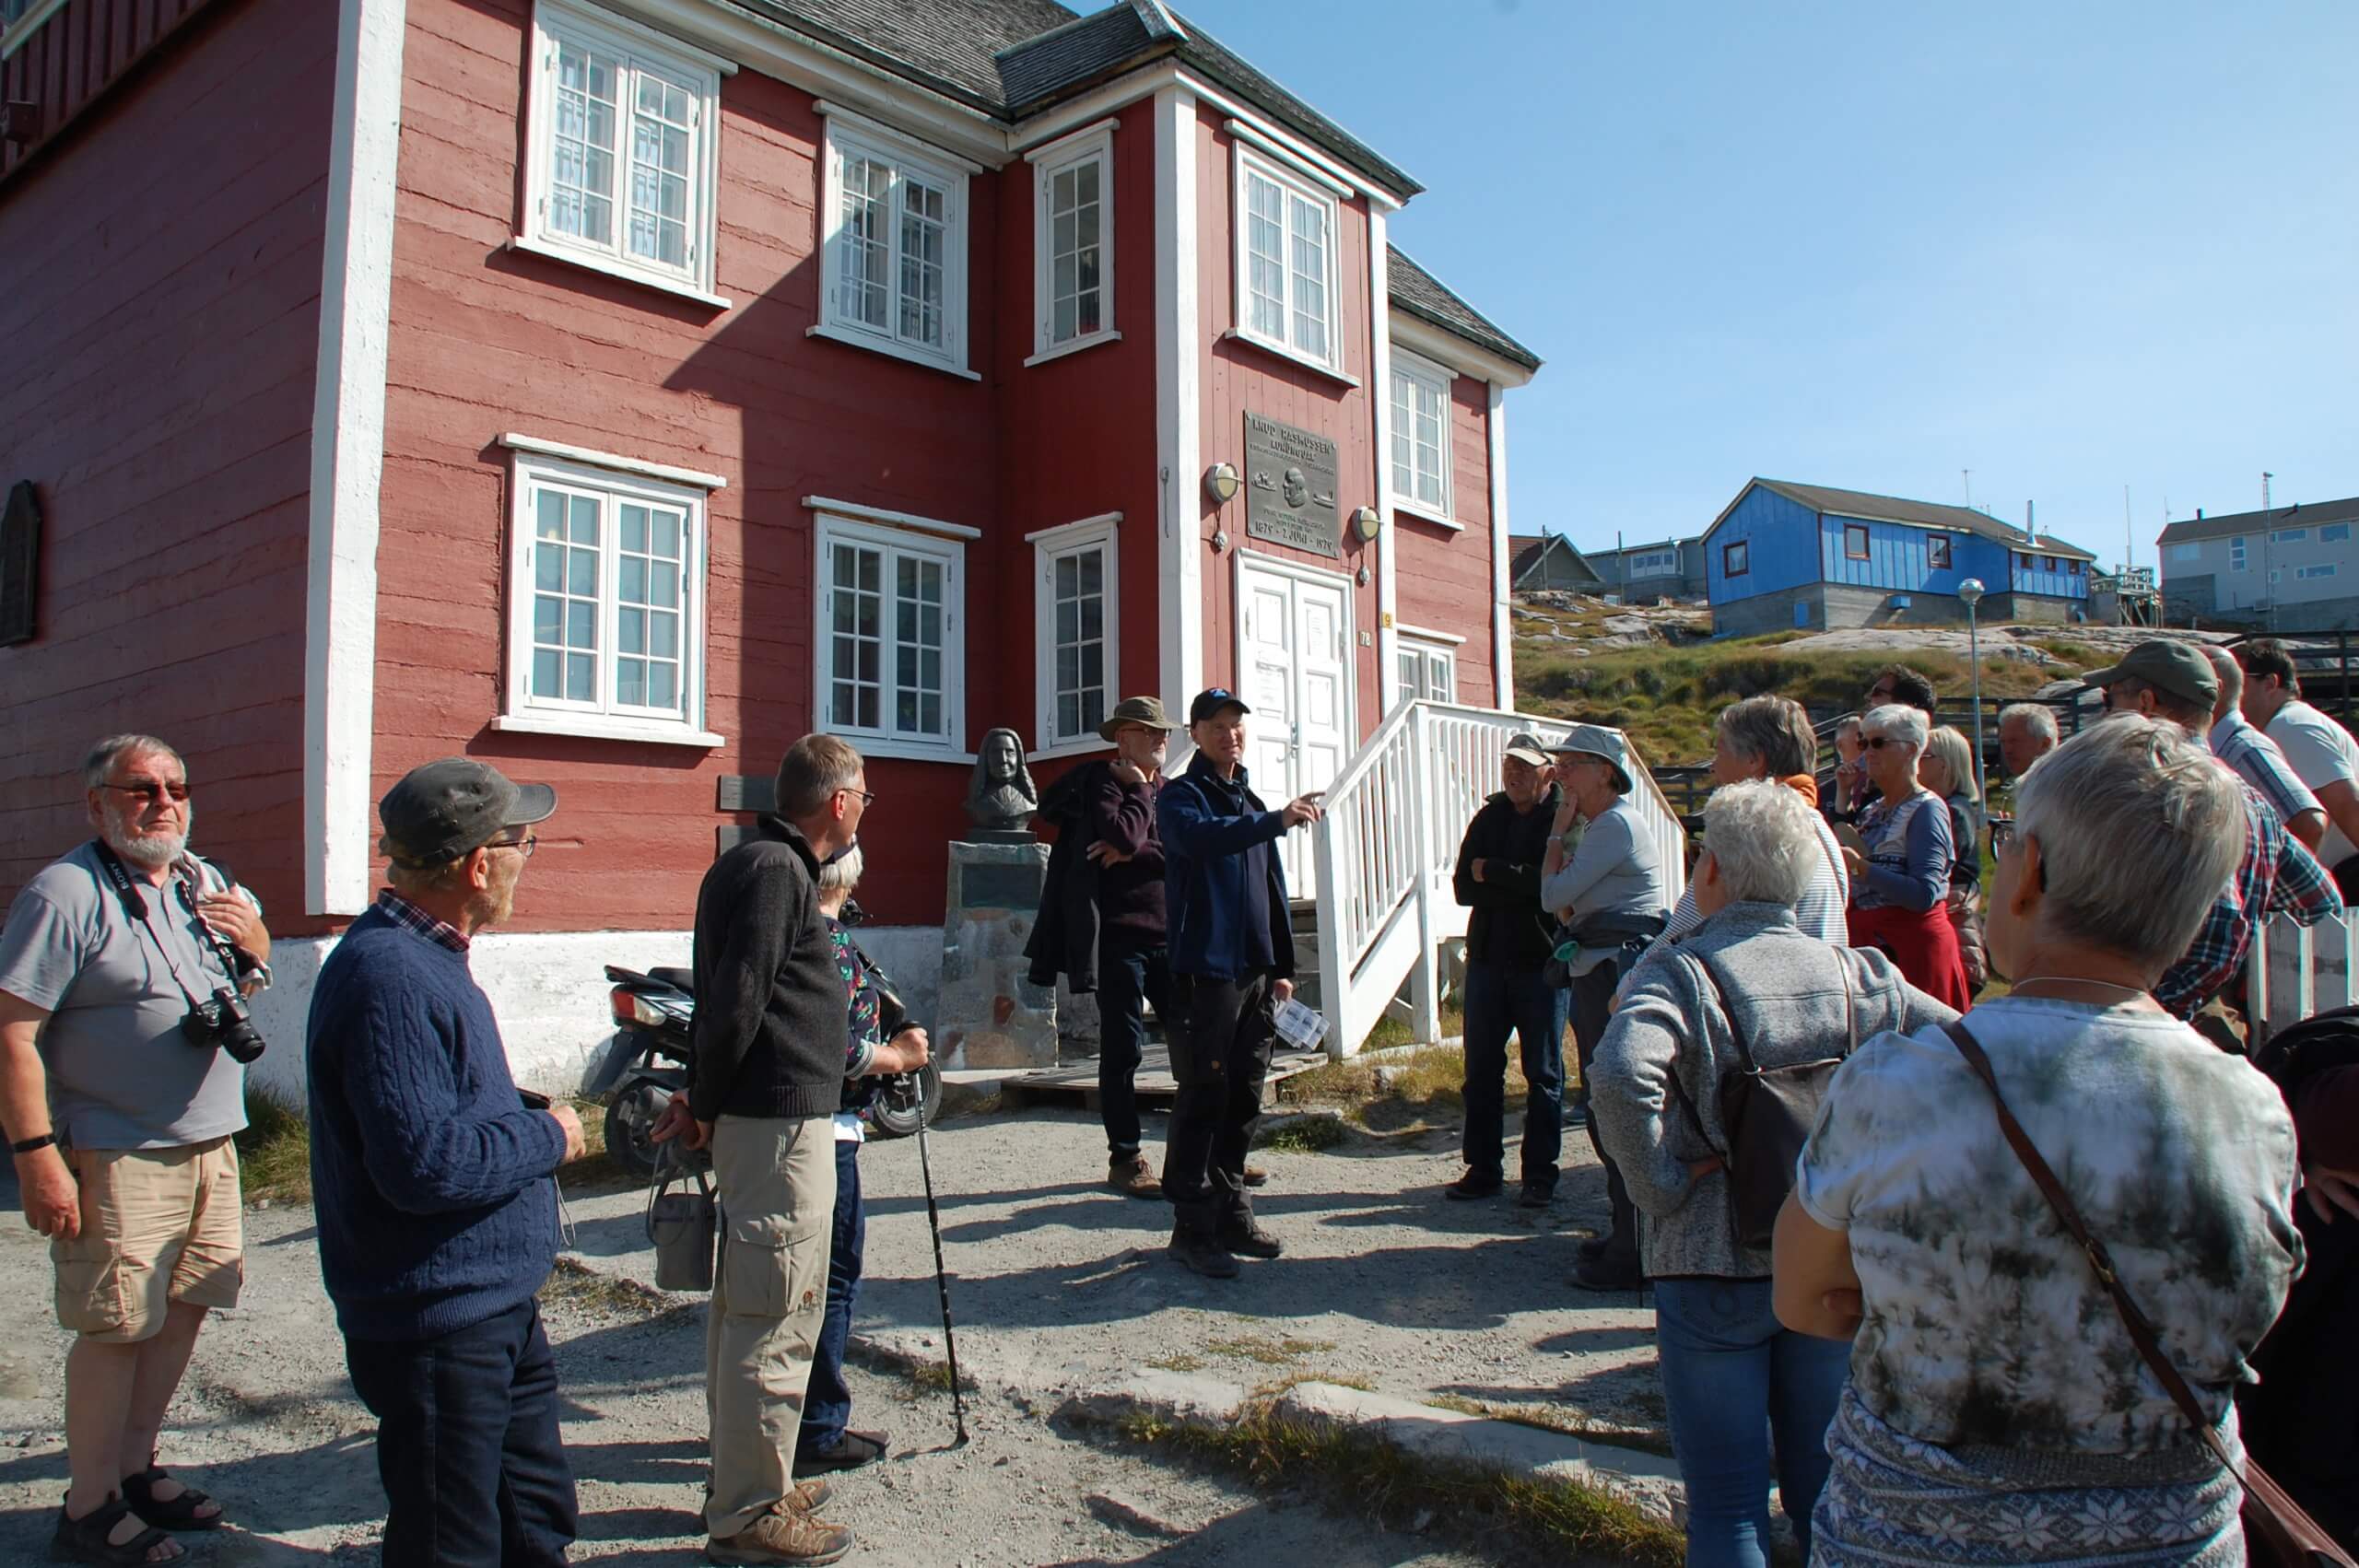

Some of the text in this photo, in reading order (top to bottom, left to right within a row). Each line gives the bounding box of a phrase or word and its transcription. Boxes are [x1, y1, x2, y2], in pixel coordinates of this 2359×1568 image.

[1385, 614, 1391, 626] 9
[1361, 631, 1371, 647] 78
[109, 862, 129, 890] SONY
